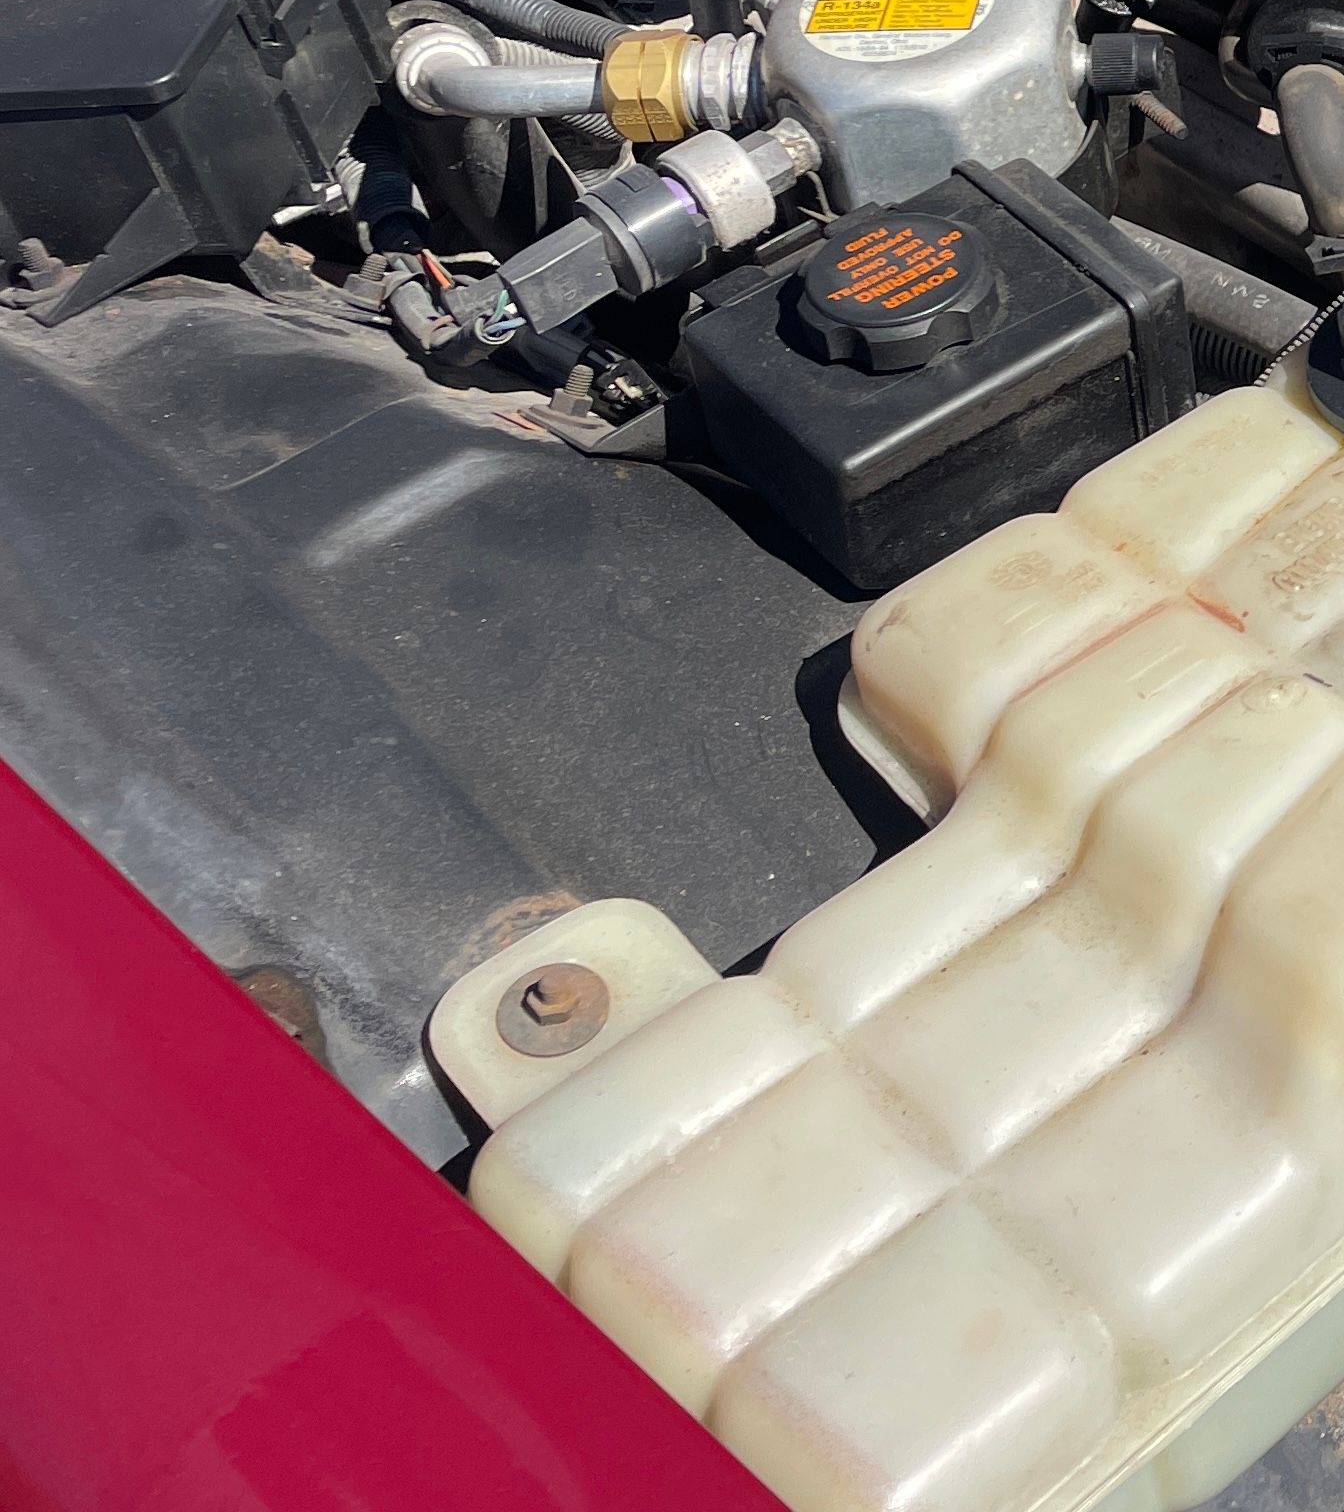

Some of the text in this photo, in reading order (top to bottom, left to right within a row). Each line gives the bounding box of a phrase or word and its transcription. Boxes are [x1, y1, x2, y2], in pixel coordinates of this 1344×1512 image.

[821, 1, 881, 11] R-134a
[836, 227, 914, 271] APPROVED
[844, 227, 889, 253] FLUID
[849, 238, 924, 279] USE ONLY
[826, 230, 962, 302] DO NOT OVERFILL
[854, 247, 956, 303] STEERING
[881, 266, 959, 309] POWER
